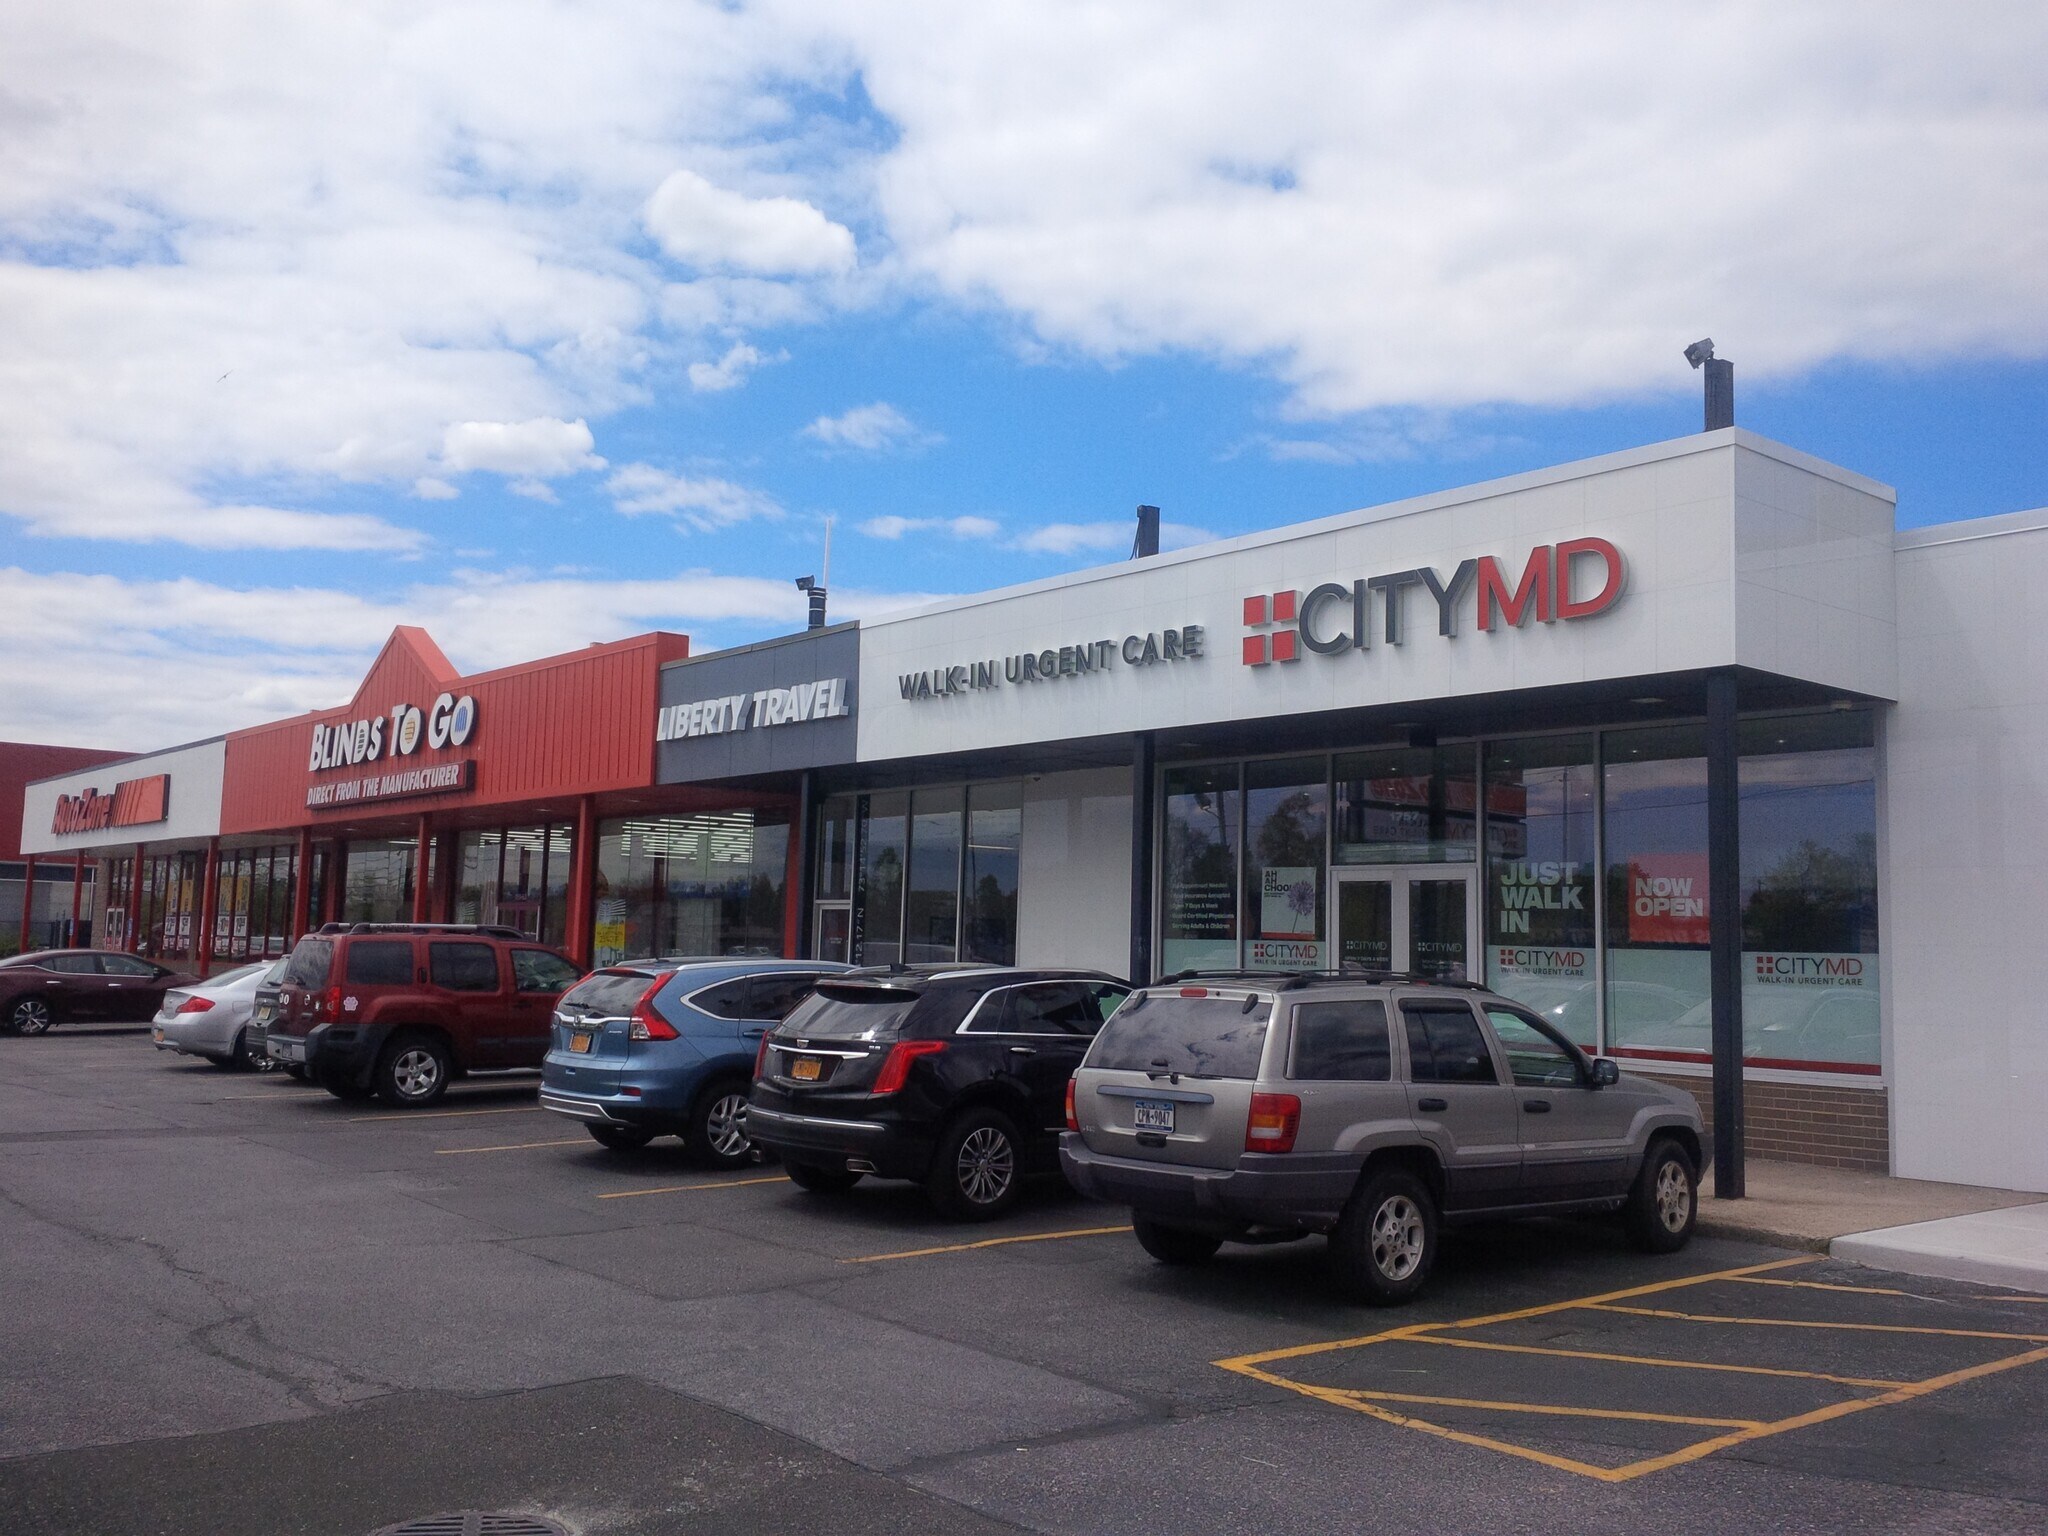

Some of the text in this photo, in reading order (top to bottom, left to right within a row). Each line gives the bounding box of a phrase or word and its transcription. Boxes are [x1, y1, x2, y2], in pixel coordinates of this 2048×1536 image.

[1299, 537, 1629, 656] CITYMD
[898, 625, 1204, 701] WALK-IN URGENT CARE
[657, 678, 848, 742] LIBERTY TRAVEL
[308, 692, 476, 772] BLINDS TO GO
[307, 764, 459, 806] DIRECT FROM THE MANUFACTURER
[51, 788, 112, 835] AutoZone
[1265, 870, 1277, 878] AH
[1501, 862, 1579, 886] JUST
[1635, 878, 1692, 896] NOW
[1501, 887, 1584, 909] WALK
[1635, 897, 1703, 917] OPEN
[1501, 910, 1530, 933] IN
[1265, 944, 1318, 959] CITYMD
[1353, 940, 1387, 951] CITYMD
[1425, 942, 1462, 952] CITYMD
[1515, 949, 1585, 967] CITYMD
[1775, 957, 1863, 976] CITYMD
[1533, 967, 1563, 976] URGENT
[1565, 968, 1584, 976] CARE
[1757, 976, 1863, 986] WALK-IN URGENT CARE
